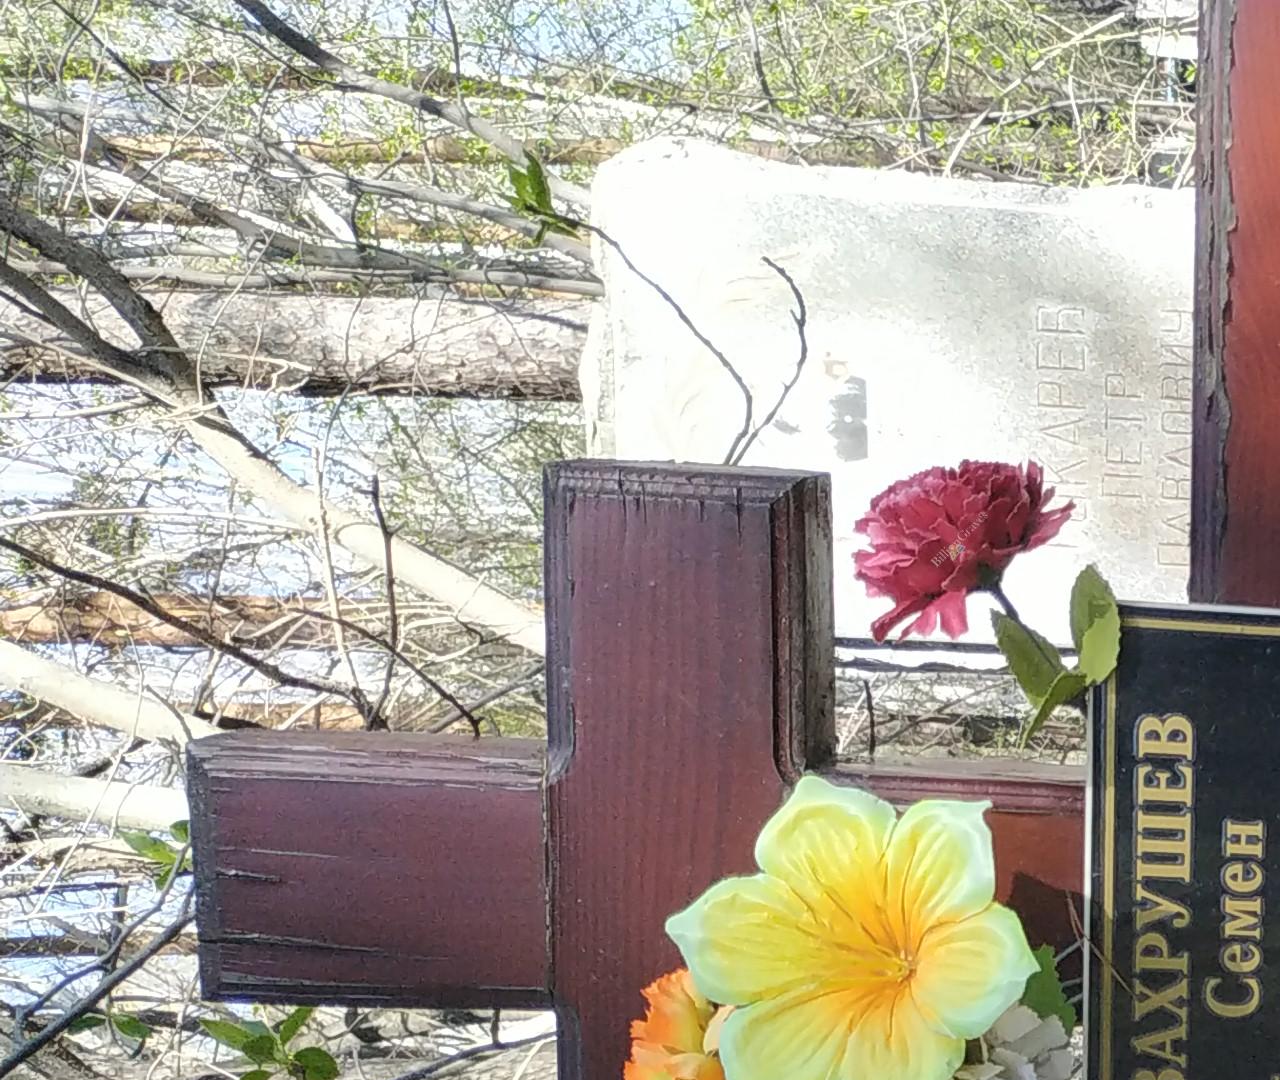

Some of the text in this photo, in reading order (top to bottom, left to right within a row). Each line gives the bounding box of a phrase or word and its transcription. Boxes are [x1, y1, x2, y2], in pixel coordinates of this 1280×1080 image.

[1034, 304, 1087, 550] ОКАРЕВ
[1099, 372, 1145, 501] ПЕТР
[1202, 816, 1266, 1020] Семен
